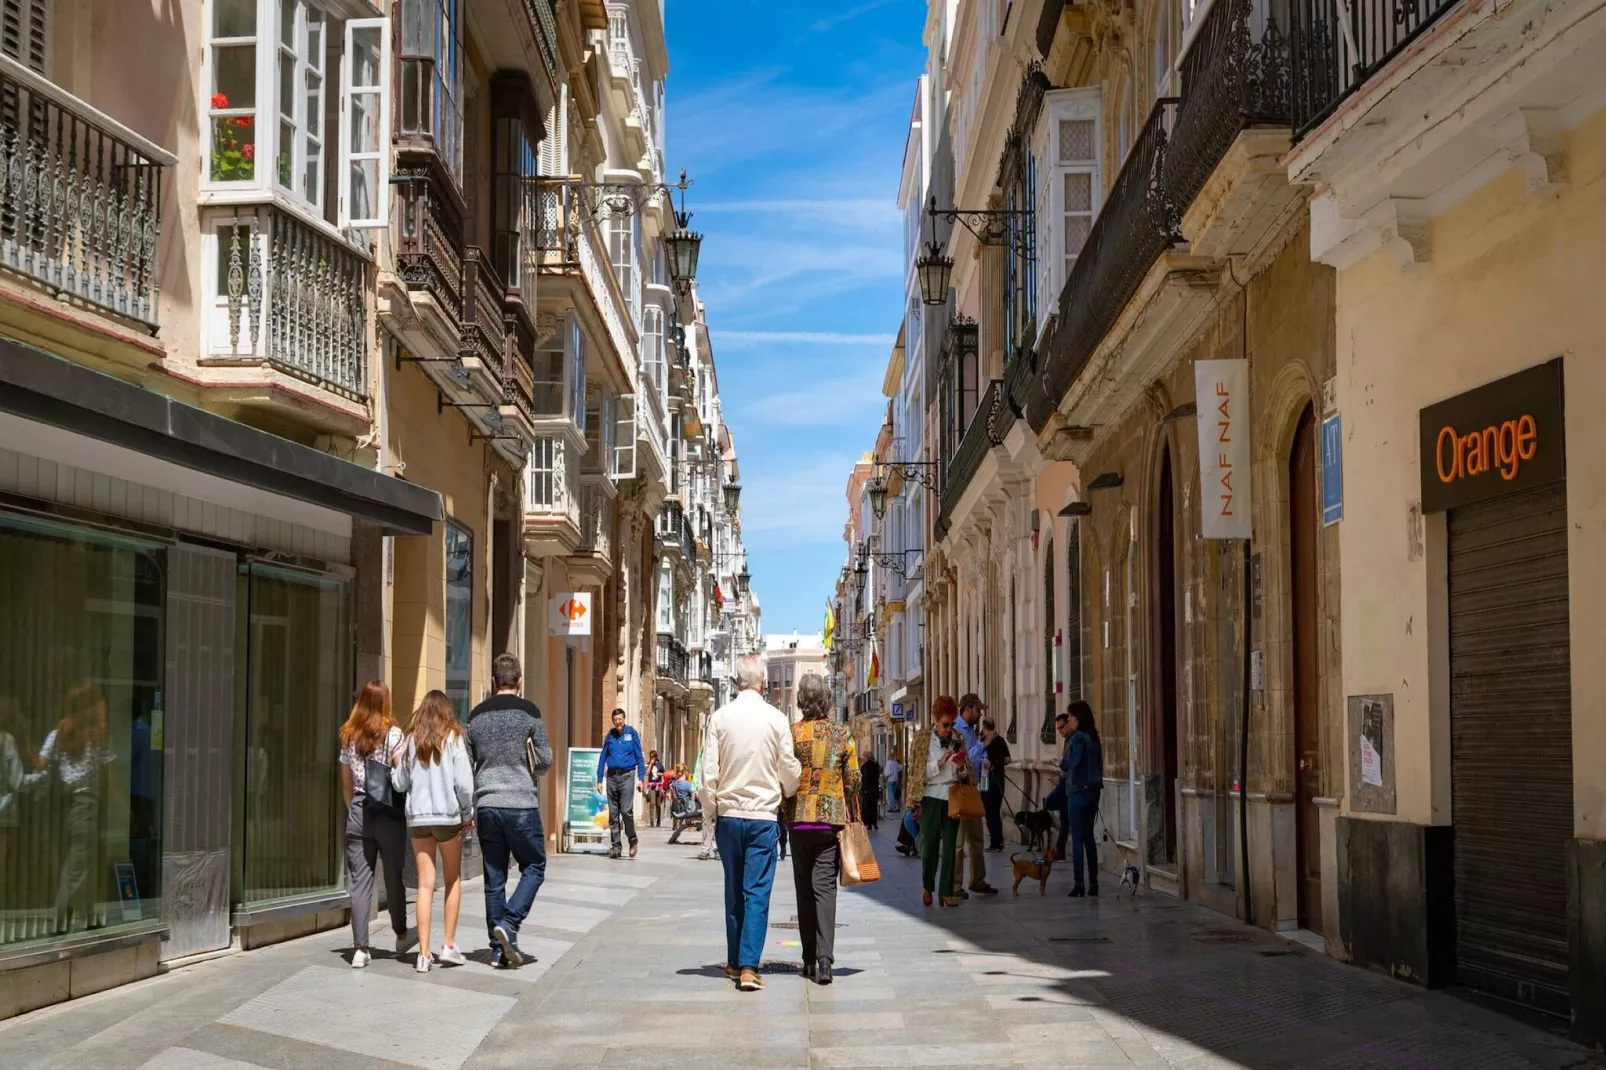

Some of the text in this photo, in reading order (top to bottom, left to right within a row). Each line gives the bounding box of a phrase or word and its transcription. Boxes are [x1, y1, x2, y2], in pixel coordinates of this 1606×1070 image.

[1216, 382, 1233, 515] NAF NAF
[1324, 423, 1339, 467] AT
[1436, 414, 1537, 482] Orange
